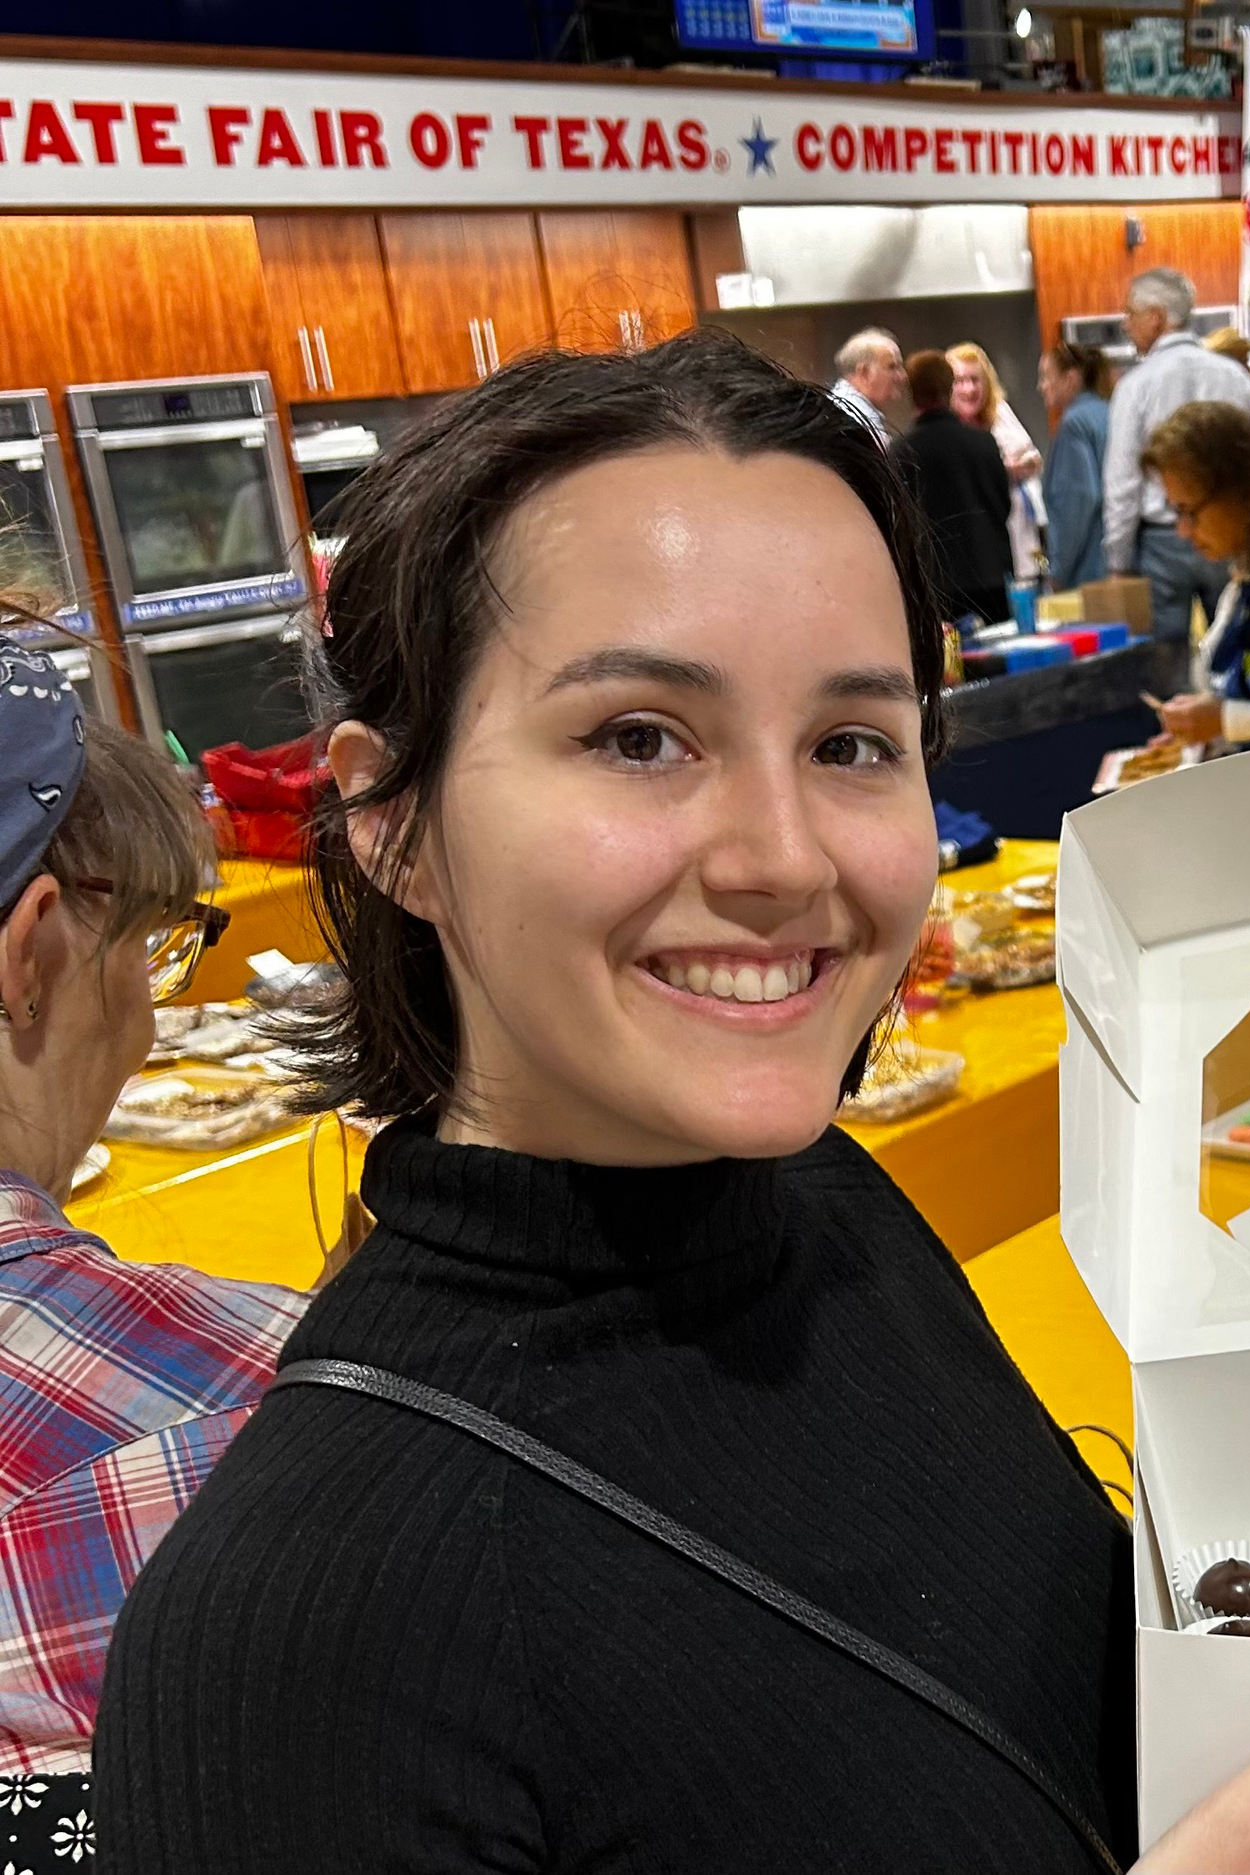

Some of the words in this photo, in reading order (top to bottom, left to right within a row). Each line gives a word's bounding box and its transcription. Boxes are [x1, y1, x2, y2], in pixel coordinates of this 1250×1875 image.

[207, 104, 390, 168] FAIR
[408, 110, 491, 171] OF
[794, 122, 1097, 176] COMPETITION
